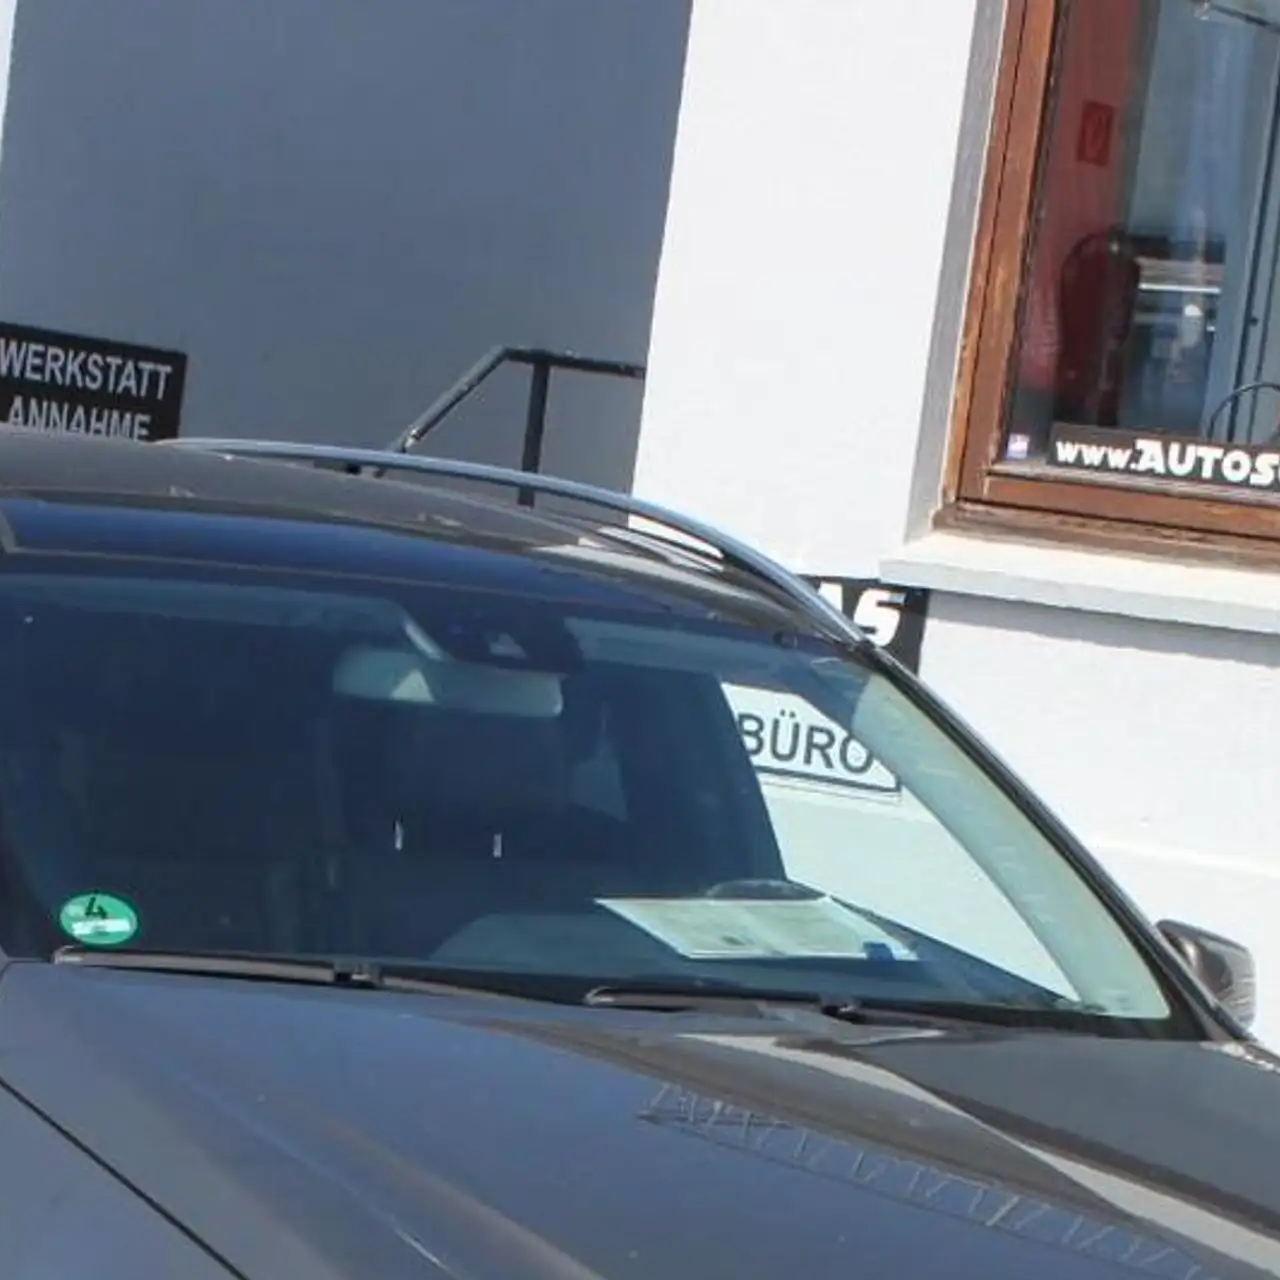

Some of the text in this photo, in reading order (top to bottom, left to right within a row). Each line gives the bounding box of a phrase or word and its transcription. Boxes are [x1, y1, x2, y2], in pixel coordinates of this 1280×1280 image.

[7, 395, 152, 443] ANNAHME
[736, 707, 875, 775] BÜRO
[84, 896, 107, 919] 4
